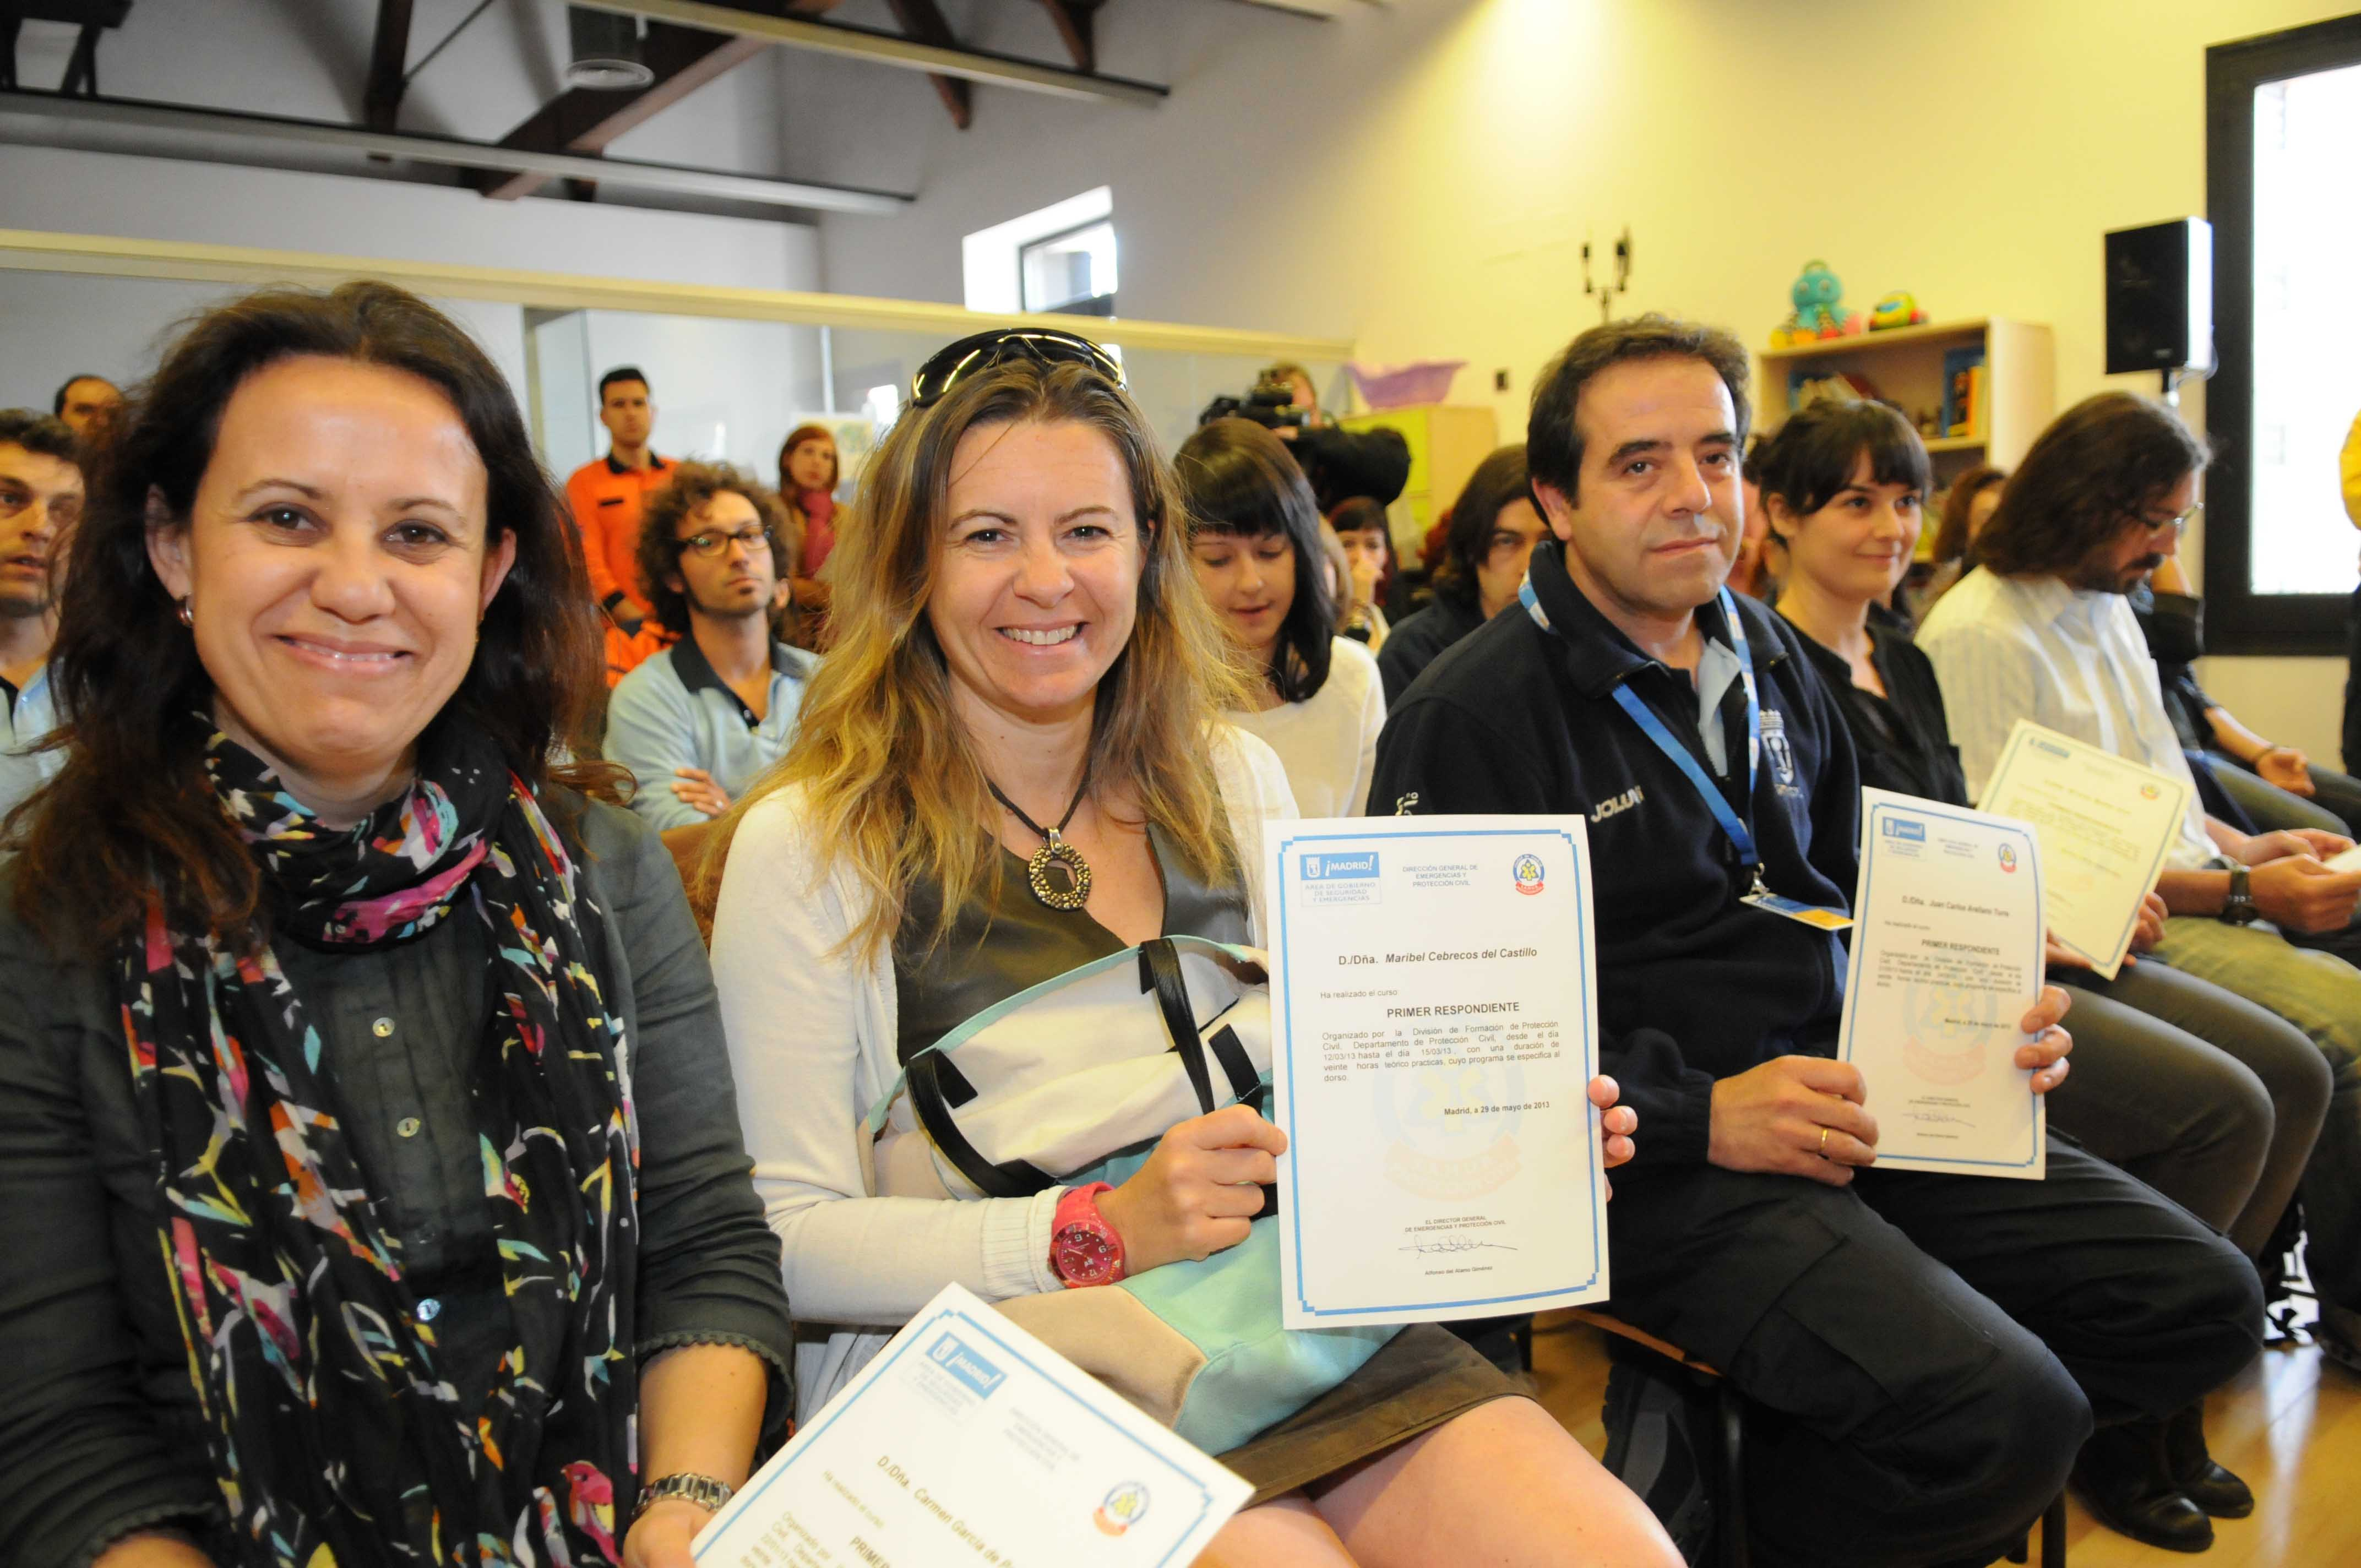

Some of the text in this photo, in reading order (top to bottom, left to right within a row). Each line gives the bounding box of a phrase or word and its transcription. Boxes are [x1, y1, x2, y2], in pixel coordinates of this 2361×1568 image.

[1922, 939, 1947, 949] PRIMER
[1339, 947, 1537, 966] D./Dña. Maribel Cebrecos del Castillo
[1333, 990, 1367, 999] realizado
[1387, 1001, 1520, 1018] PRIMER RESPONDIENTE
[1322, 1031, 1368, 1041] Organizado
[1372, 1031, 1385, 1039] por
[1413, 1027, 1442, 1036] División
[1465, 1023, 1503, 1033] Formación
[1522, 1020, 1558, 1030] Protección
[1353, 1039, 1409, 1050] Departamento
[1429, 1036, 1468, 1045] Protección
[1506, 1032, 1528, 1041] desde
[1324, 1052, 1356, 1061] 12/03/13
[1514, 1042, 1544, 1050] duración
[1324, 1063, 1347, 1071] veinte
[1449, 1058, 1466, 1066] cuyo
[1469, 1055, 1504, 1065] programa
[1444, 1107, 1472, 1115] Madrid,
[1502, 1104, 1521, 1113] mayo
[1534, 1101, 1550, 1109] 2013
[914, 1488, 953, 1523] Carmen
[984, 1549, 999, 1564] de
